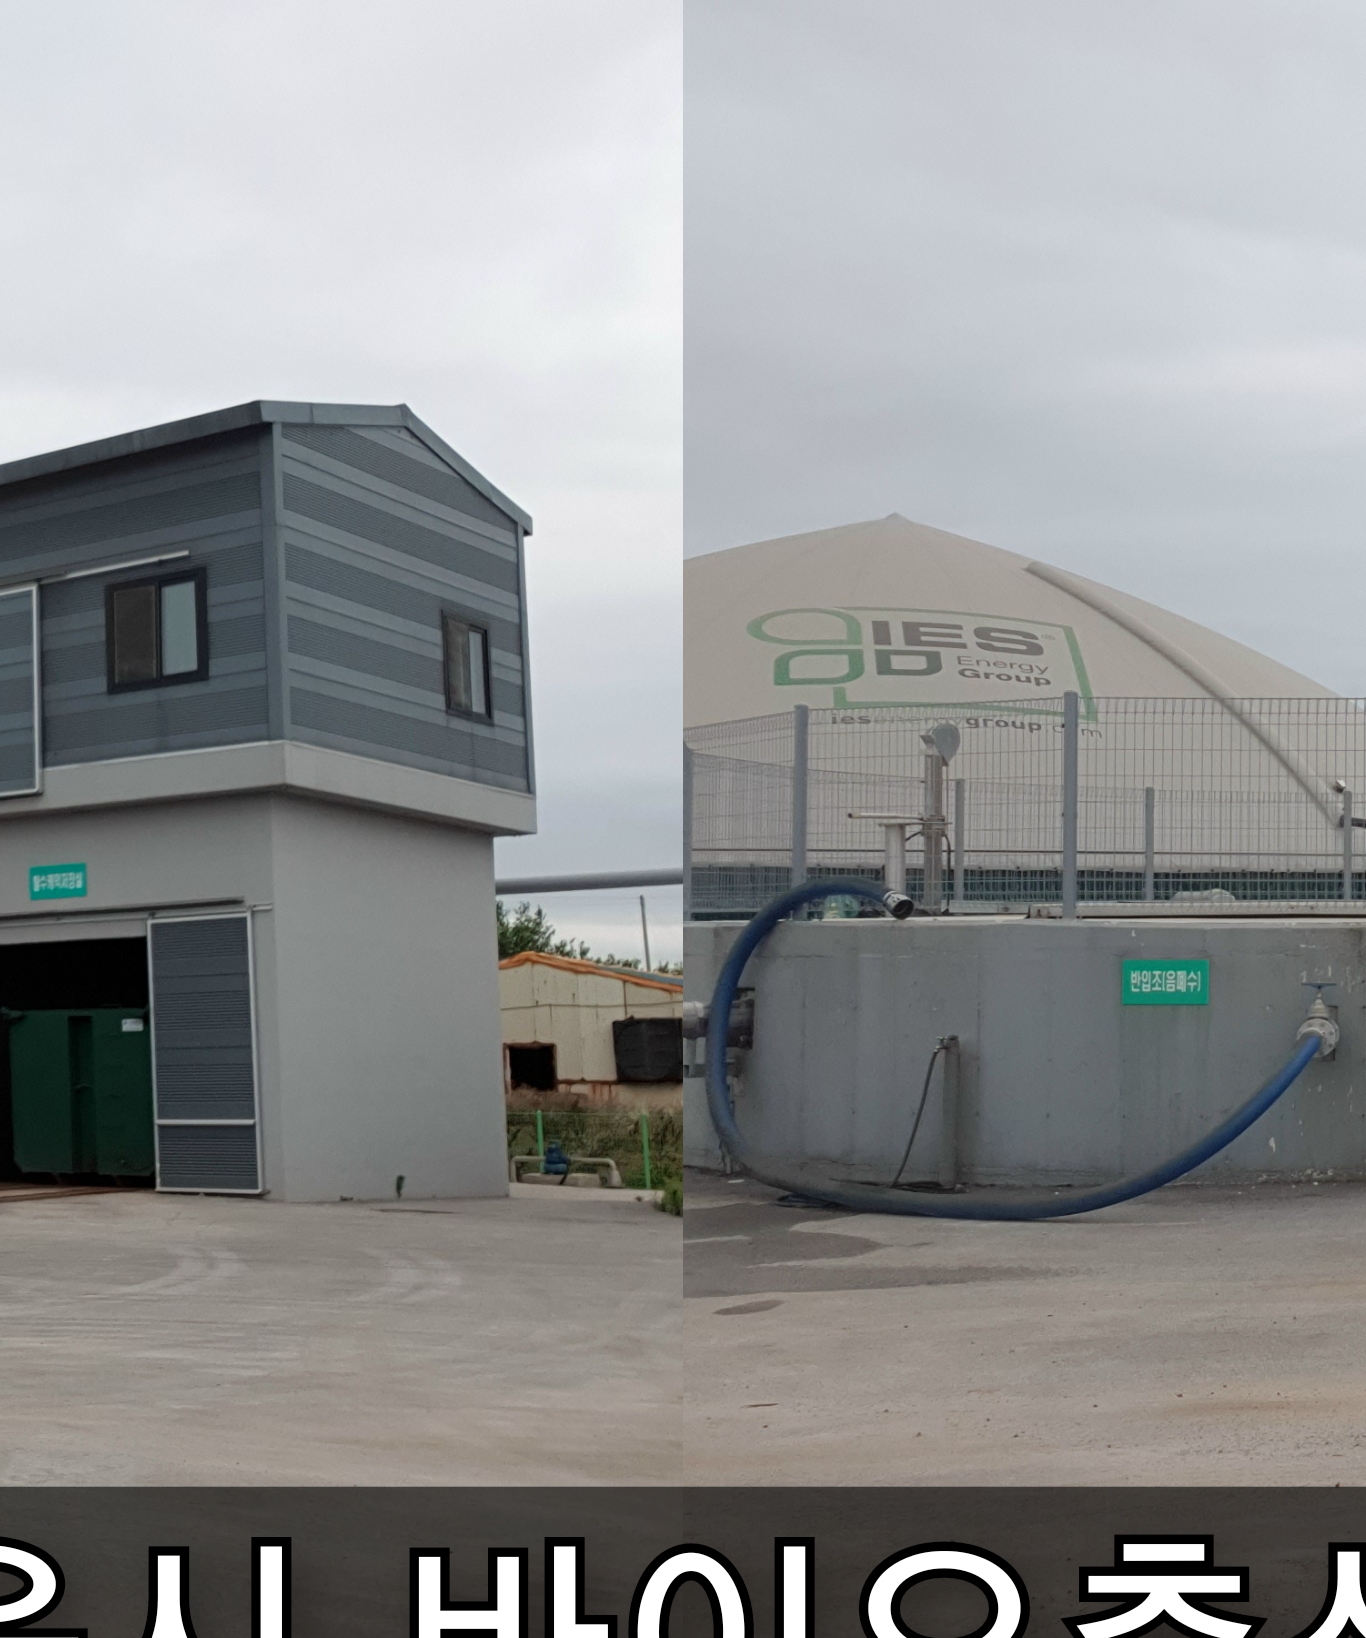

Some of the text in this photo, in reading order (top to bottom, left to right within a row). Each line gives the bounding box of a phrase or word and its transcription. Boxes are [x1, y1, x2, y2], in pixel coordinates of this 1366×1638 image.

[872, 620, 1045, 656] IES
[956, 655, 1049, 675] Energy
[958, 668, 1052, 686] Group
[1130, 970, 1201, 992] 반입조(음폐수)
